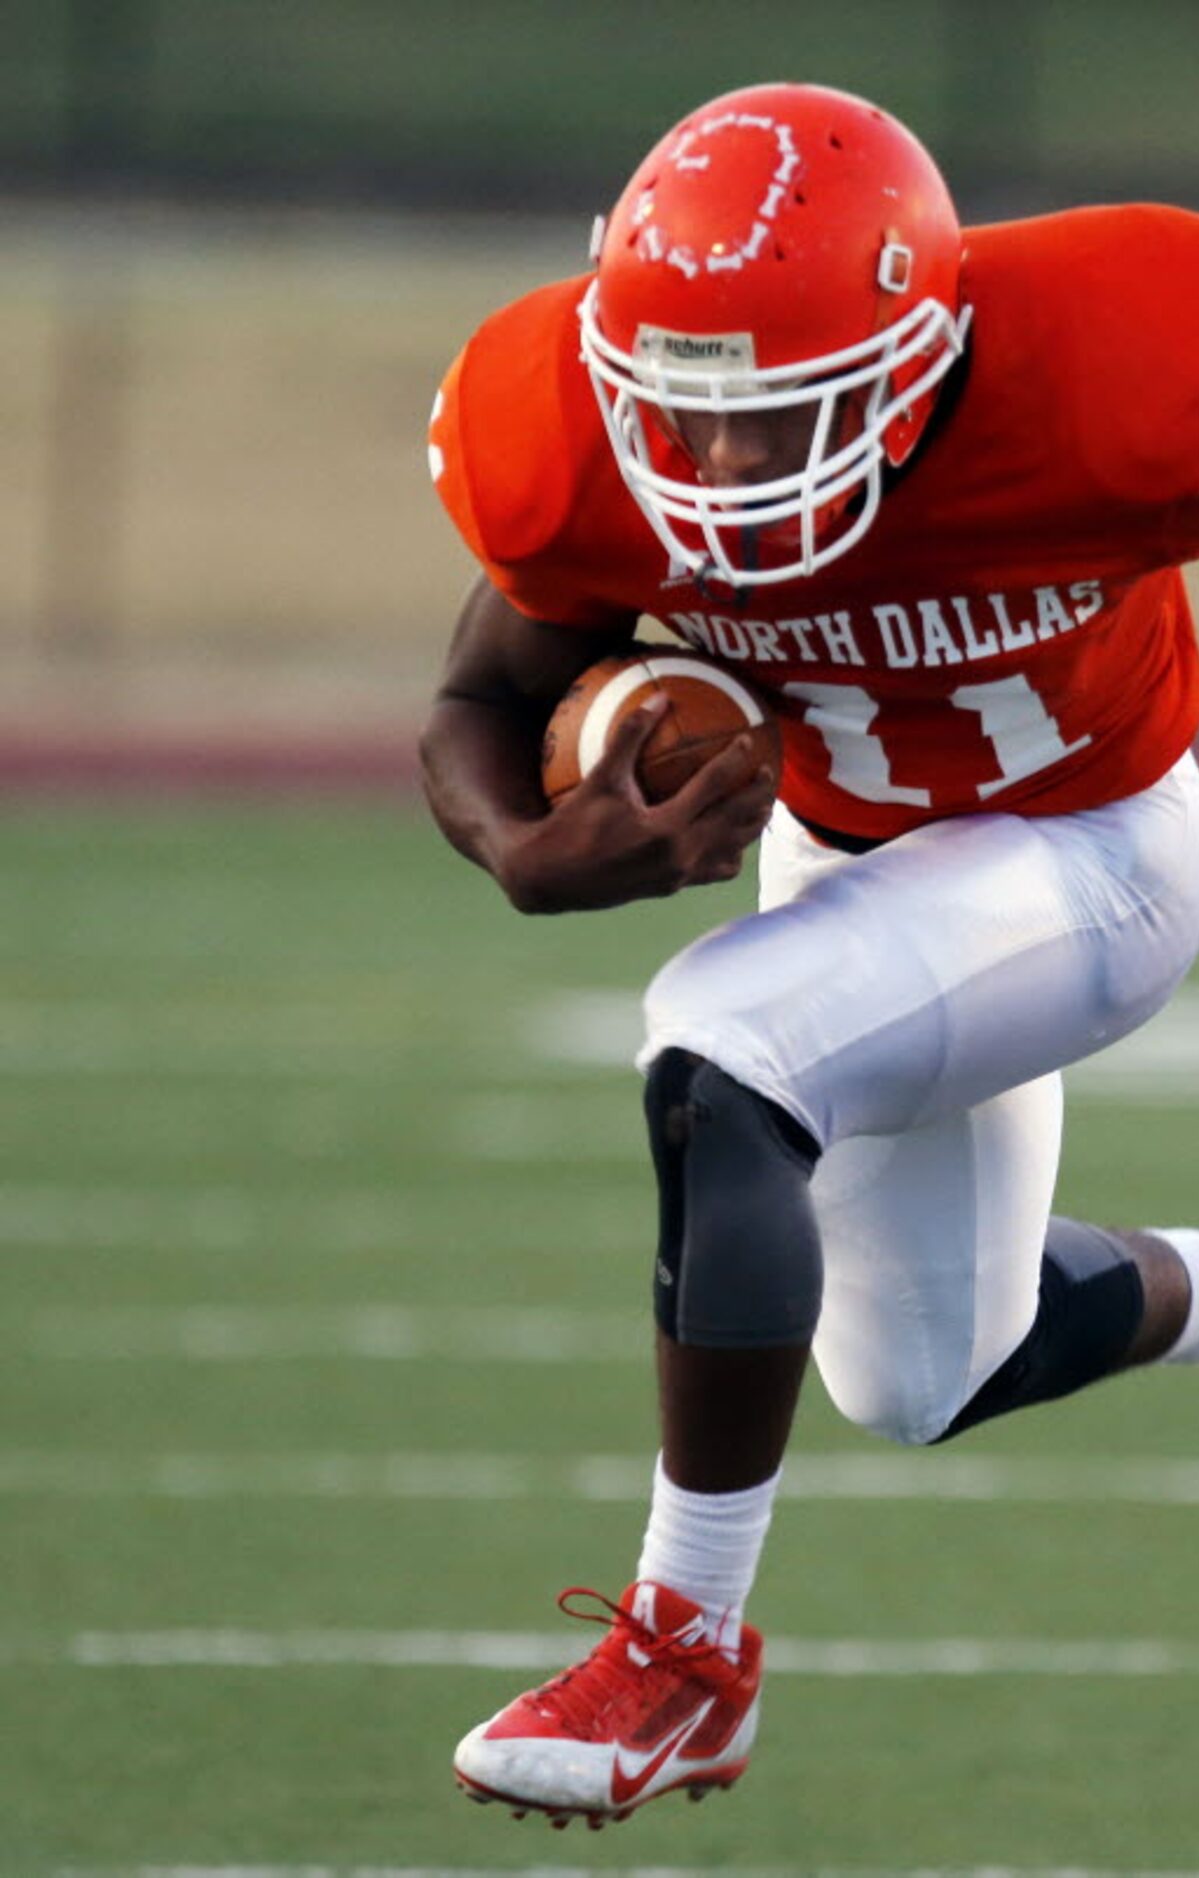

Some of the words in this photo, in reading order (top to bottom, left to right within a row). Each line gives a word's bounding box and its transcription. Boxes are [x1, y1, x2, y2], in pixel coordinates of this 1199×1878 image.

[669, 610, 866, 666] NORTH
[872, 579, 1104, 668] DALLAS
[782, 673, 1093, 808] 11
